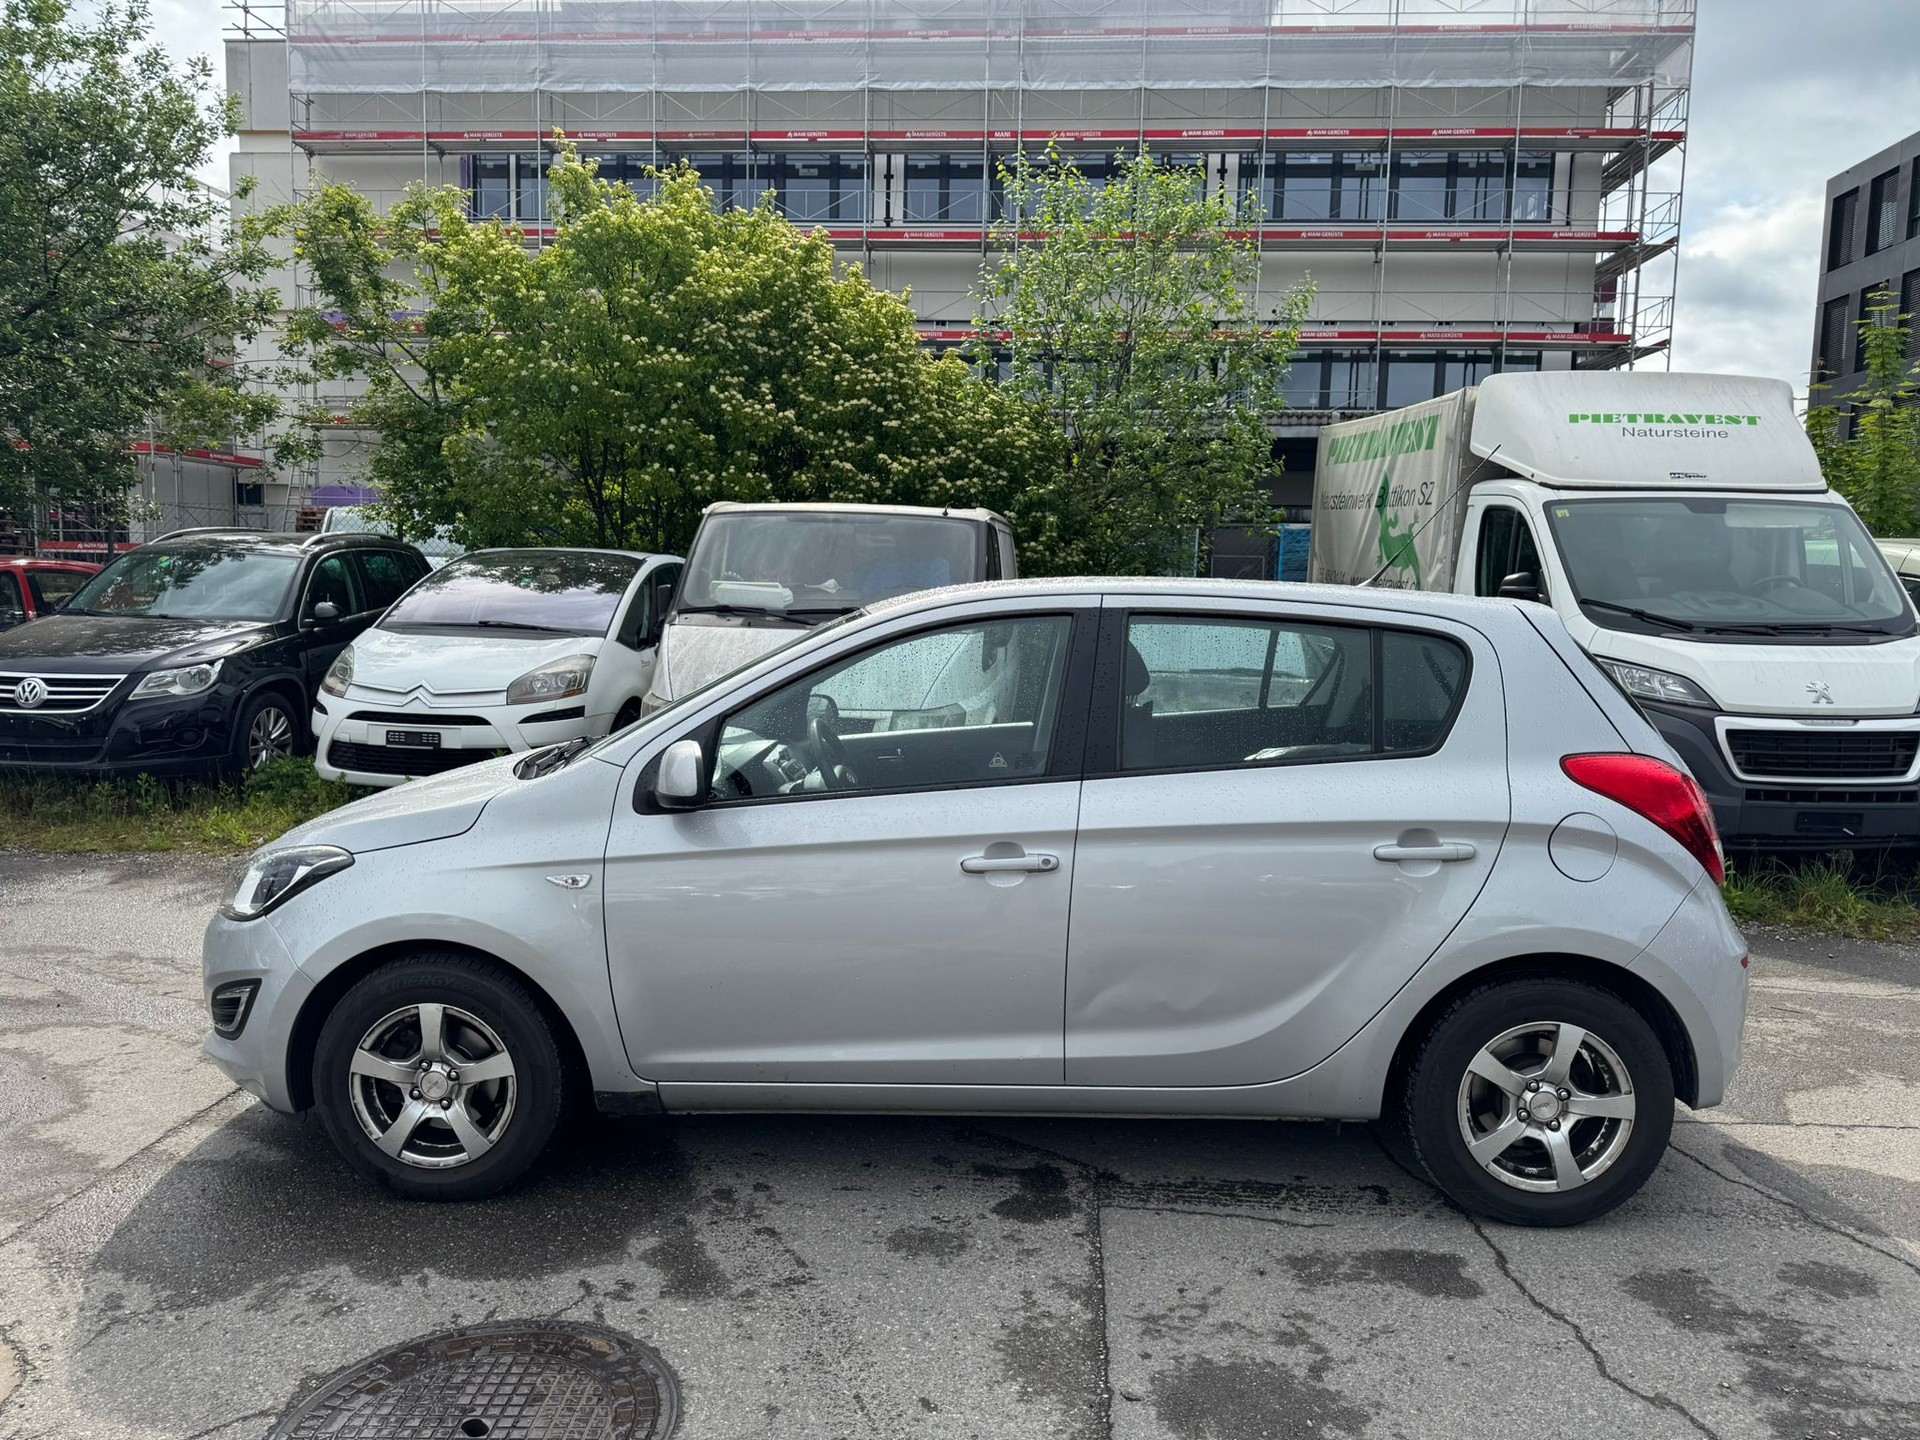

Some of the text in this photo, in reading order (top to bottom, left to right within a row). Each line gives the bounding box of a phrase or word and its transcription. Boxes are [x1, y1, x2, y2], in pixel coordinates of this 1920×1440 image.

[1568, 413, 1761, 426] PIETRAVEST
[1622, 427, 1729, 439] Natursteine
[1320, 489, 1373, 510] Nrsteinwerk
[1418, 481, 1435, 506] SZ
